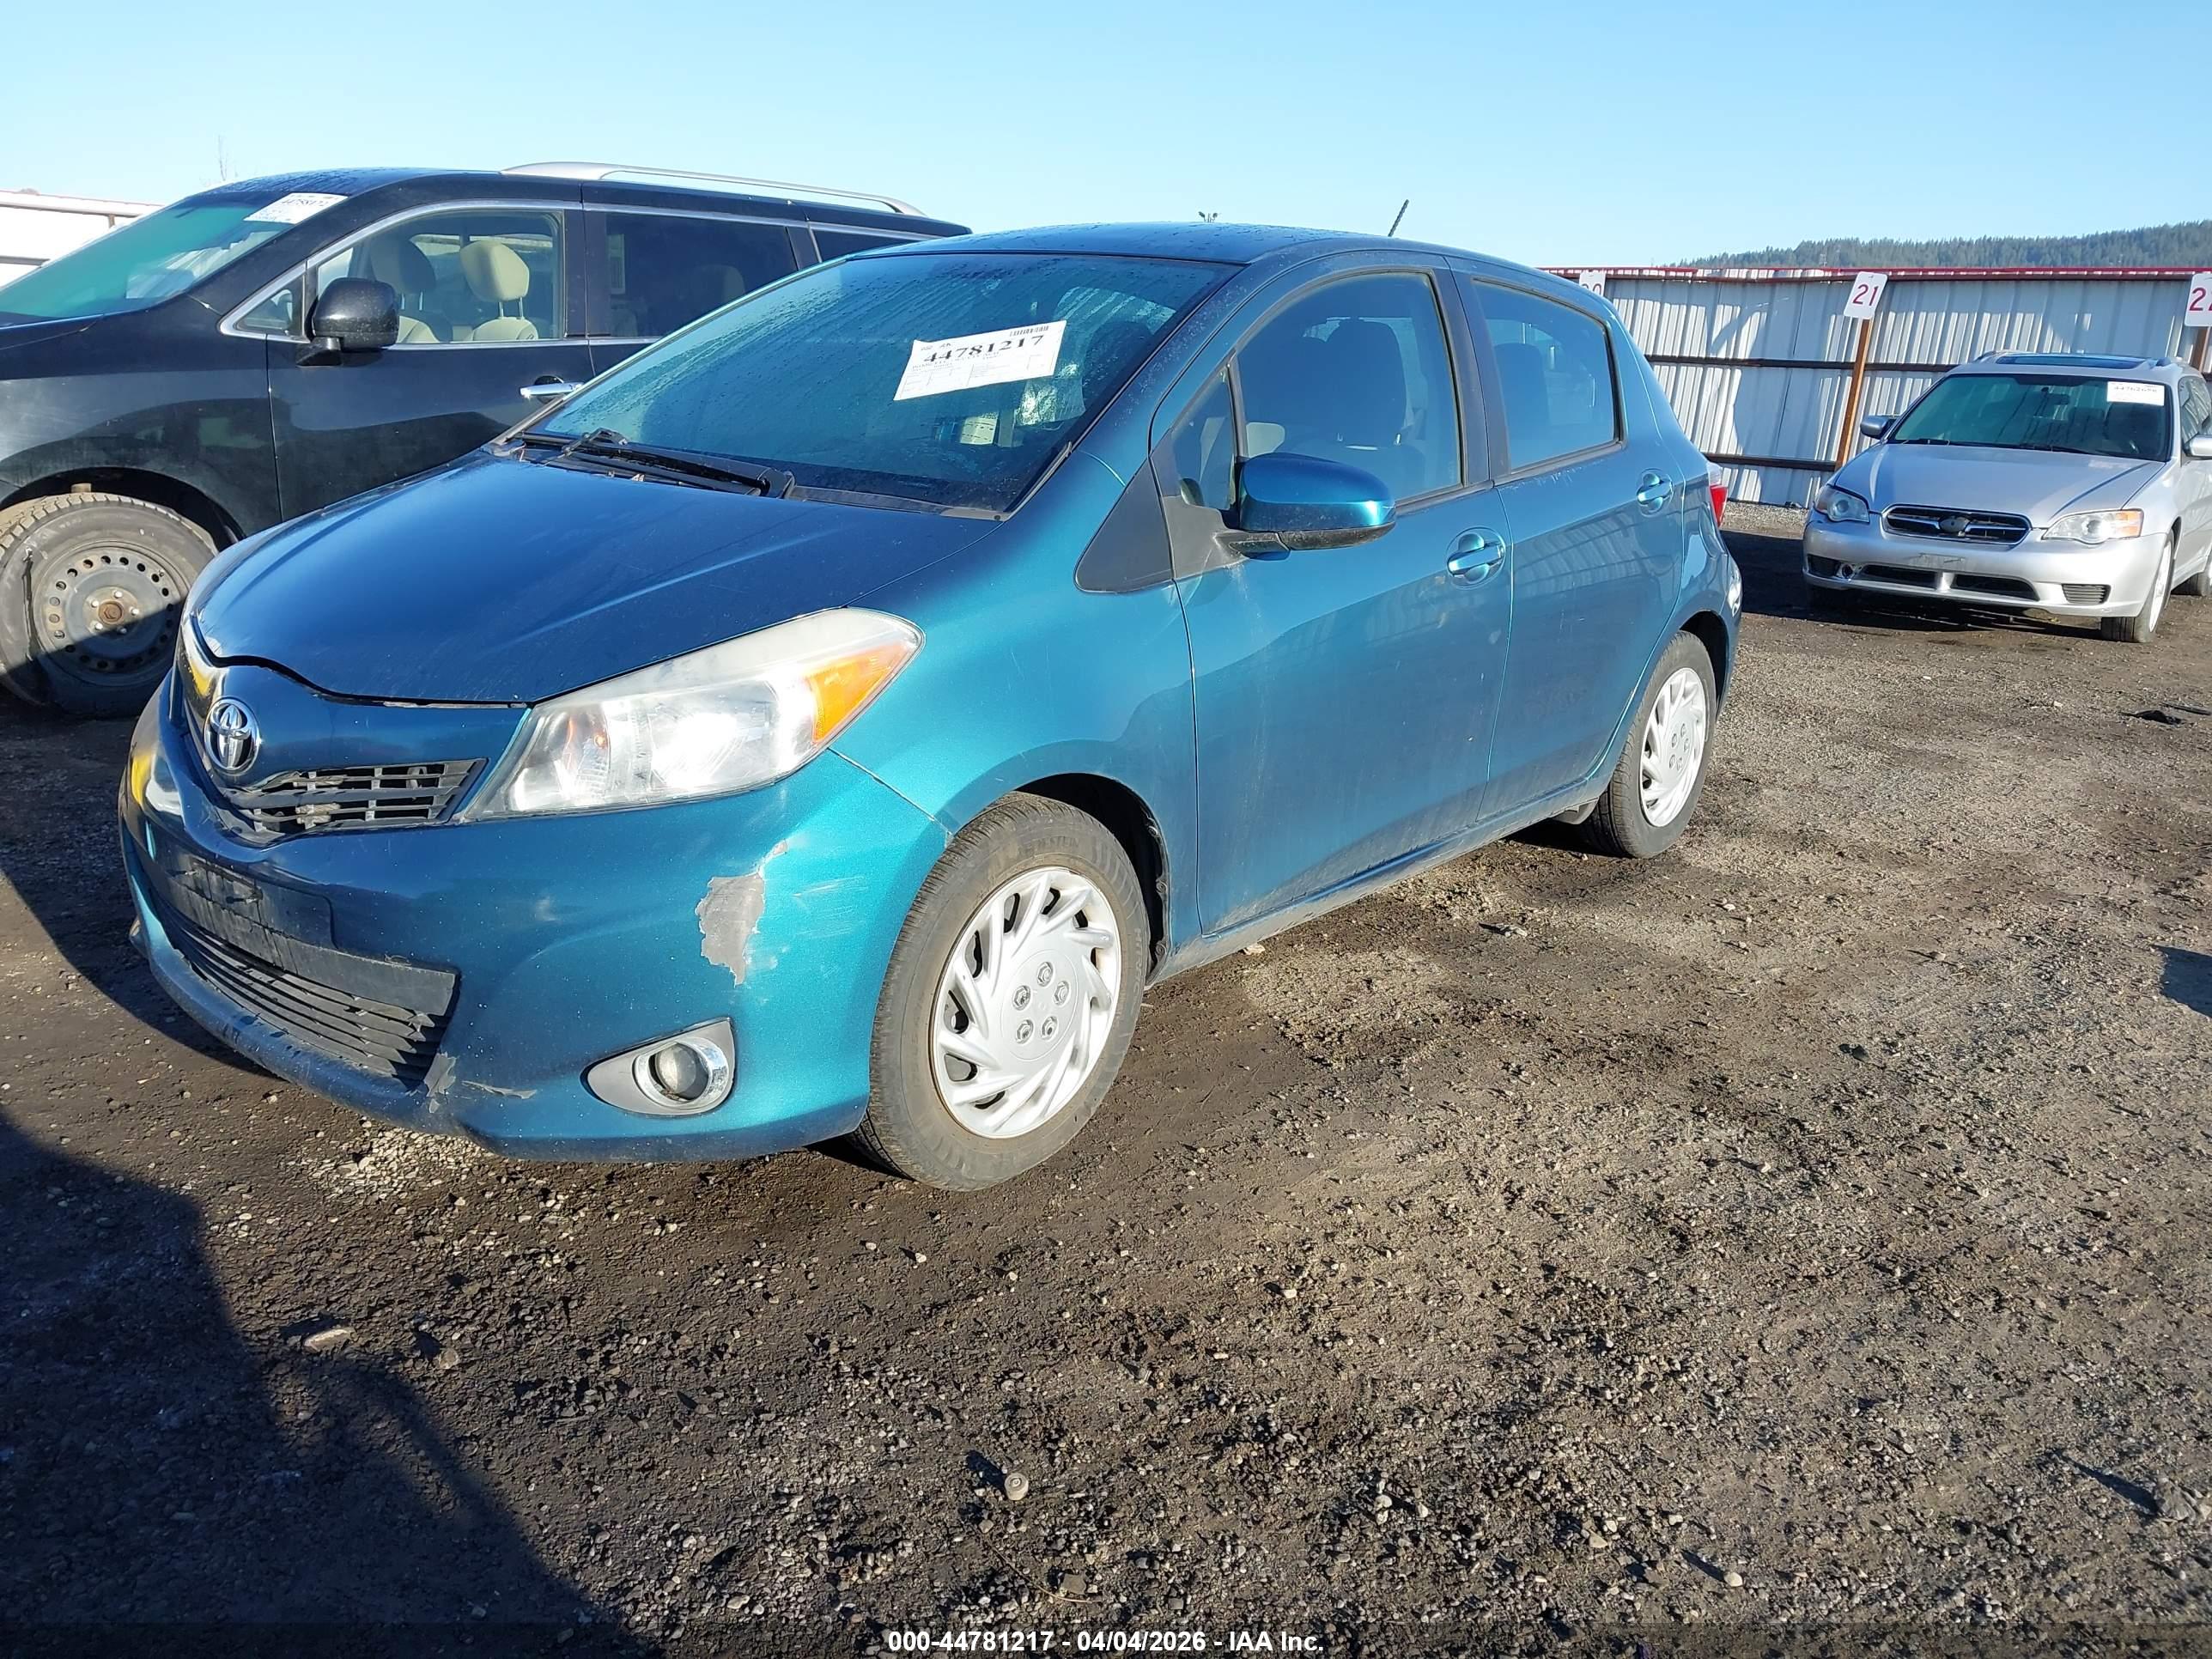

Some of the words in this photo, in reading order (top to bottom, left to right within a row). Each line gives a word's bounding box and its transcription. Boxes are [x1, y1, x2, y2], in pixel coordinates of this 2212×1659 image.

[1852, 284, 1879, 307] 21
[2189, 287, 2212, 312] 2
[923, 334, 1044, 362] 44781217
